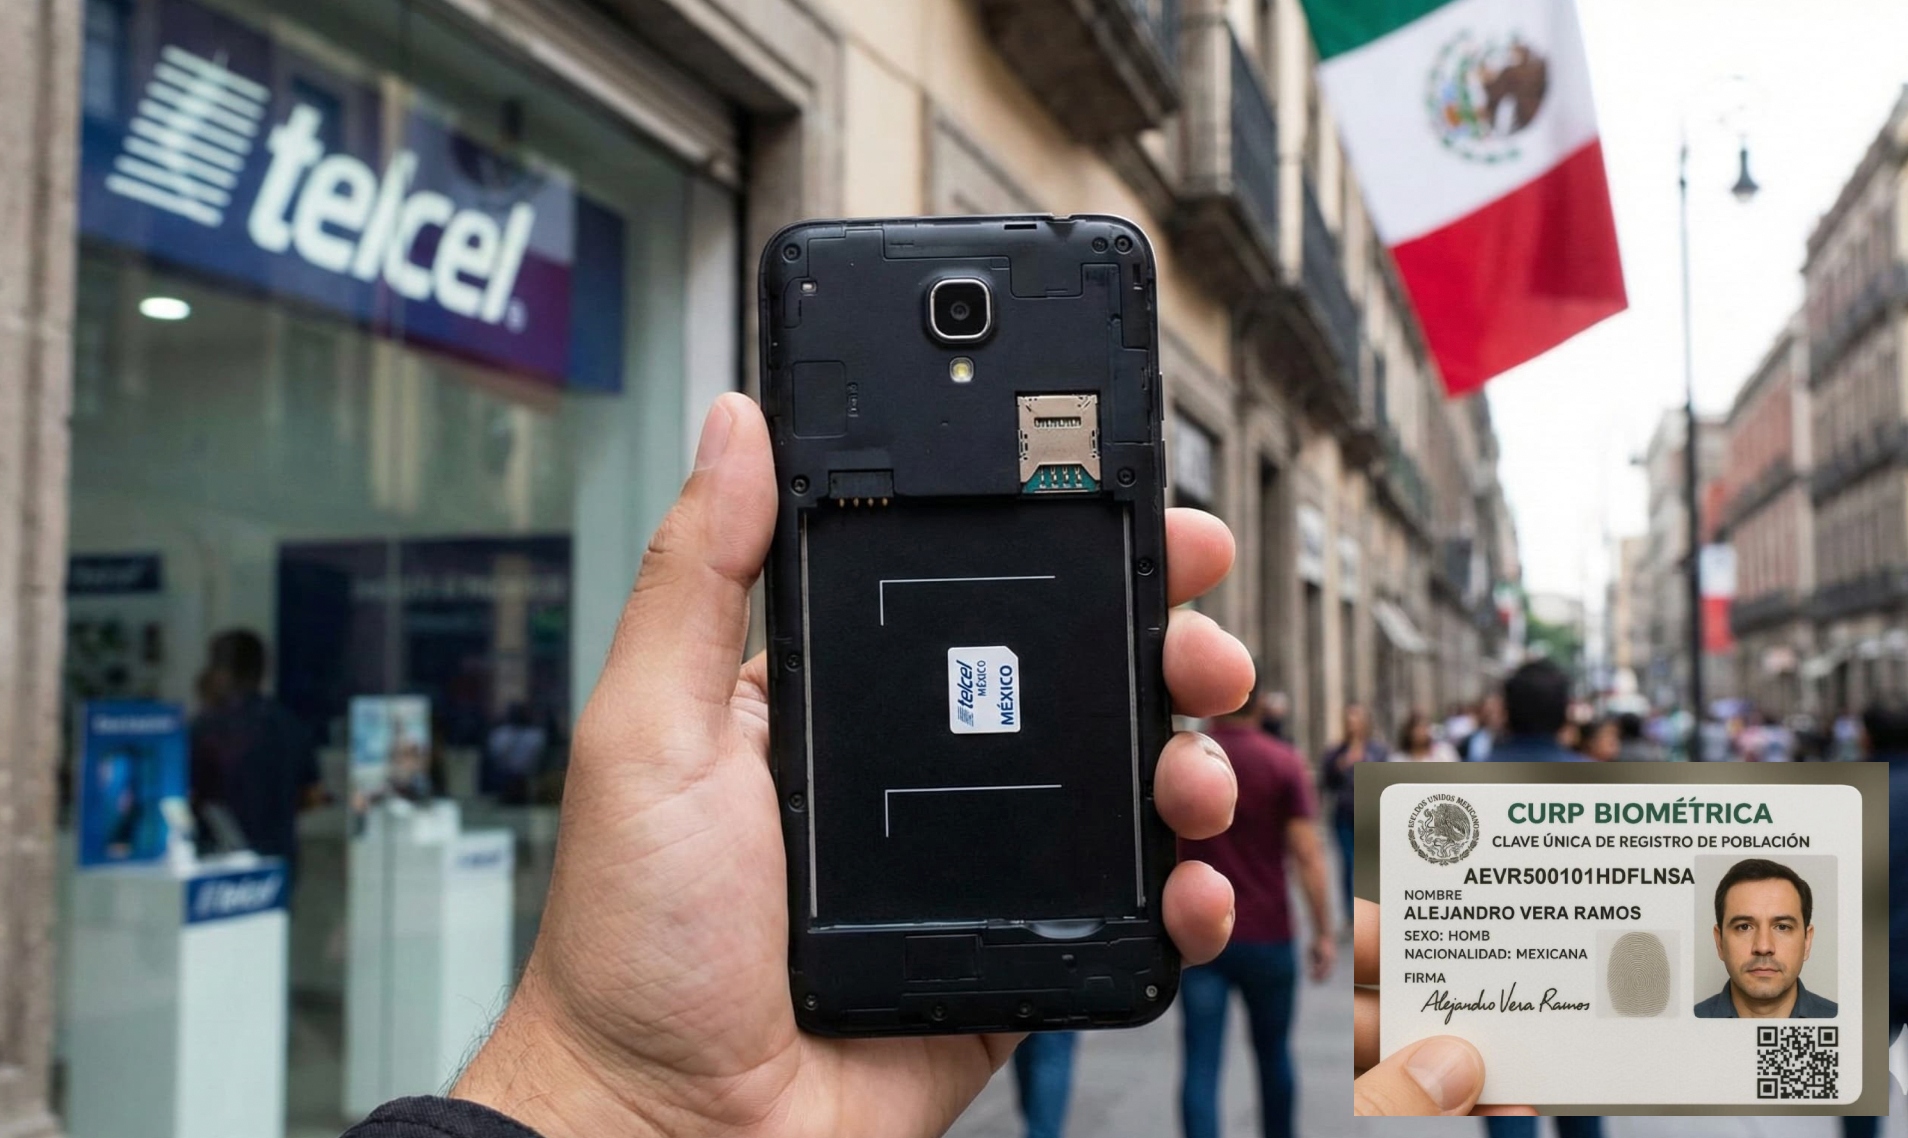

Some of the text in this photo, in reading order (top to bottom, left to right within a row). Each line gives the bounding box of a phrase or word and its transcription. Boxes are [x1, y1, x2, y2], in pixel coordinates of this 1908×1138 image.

[247, 102, 535, 324] telcel
[956, 659, 974, 709] telcel
[976, 660, 987, 697] MÉXICO
[996, 665, 1014, 725] MÉXICO
[1427, 793, 1455, 803] UNIDOS
[1507, 802, 1585, 824] CURP
[1492, 832, 1810, 848] CLAVE ÚNICA DE REGISTRO DE POBLACIÓN
[1463, 867, 1695, 885] AEVR500101HDFLNSA
[1404, 889, 1463, 901] NOMBRE
[1403, 905, 1642, 920] ALEJANDRO VERA RAMOS
[1404, 930, 1491, 942] SEXO: HOMB
[1404, 948, 1588, 960] NACIONALIDAD: MEXICANA
[1404, 972, 1446, 984] FIRMA
[1499, 981, 1535, 1013] Vera
[1539, 987, 1591, 1013] Ramos
